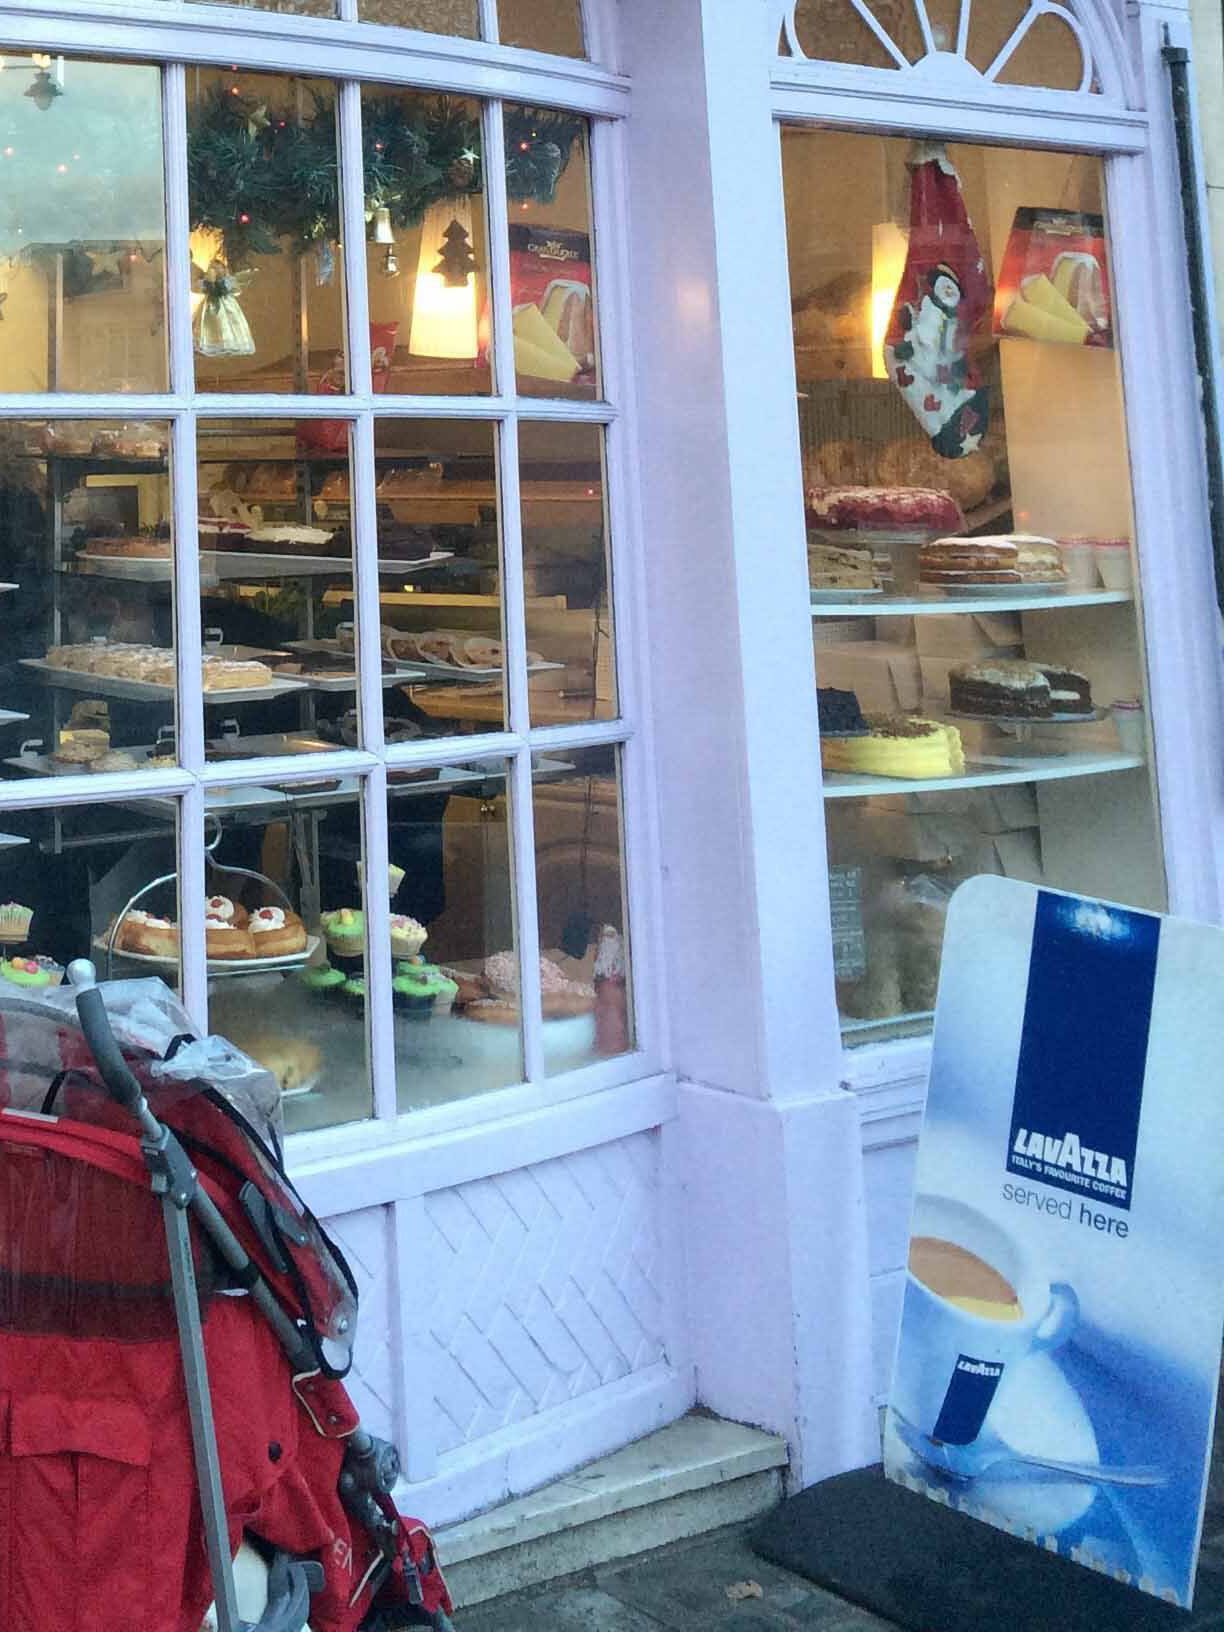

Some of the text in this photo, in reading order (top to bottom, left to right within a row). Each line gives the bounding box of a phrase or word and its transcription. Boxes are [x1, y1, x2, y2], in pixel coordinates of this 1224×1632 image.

[1013, 1127, 1128, 1188] LAVAZZA
[1043, 1165, 1092, 1190] FAVOURITE
[1092, 1179, 1129, 1201] COFFEE
[1001, 1182, 1129, 1239] served here
